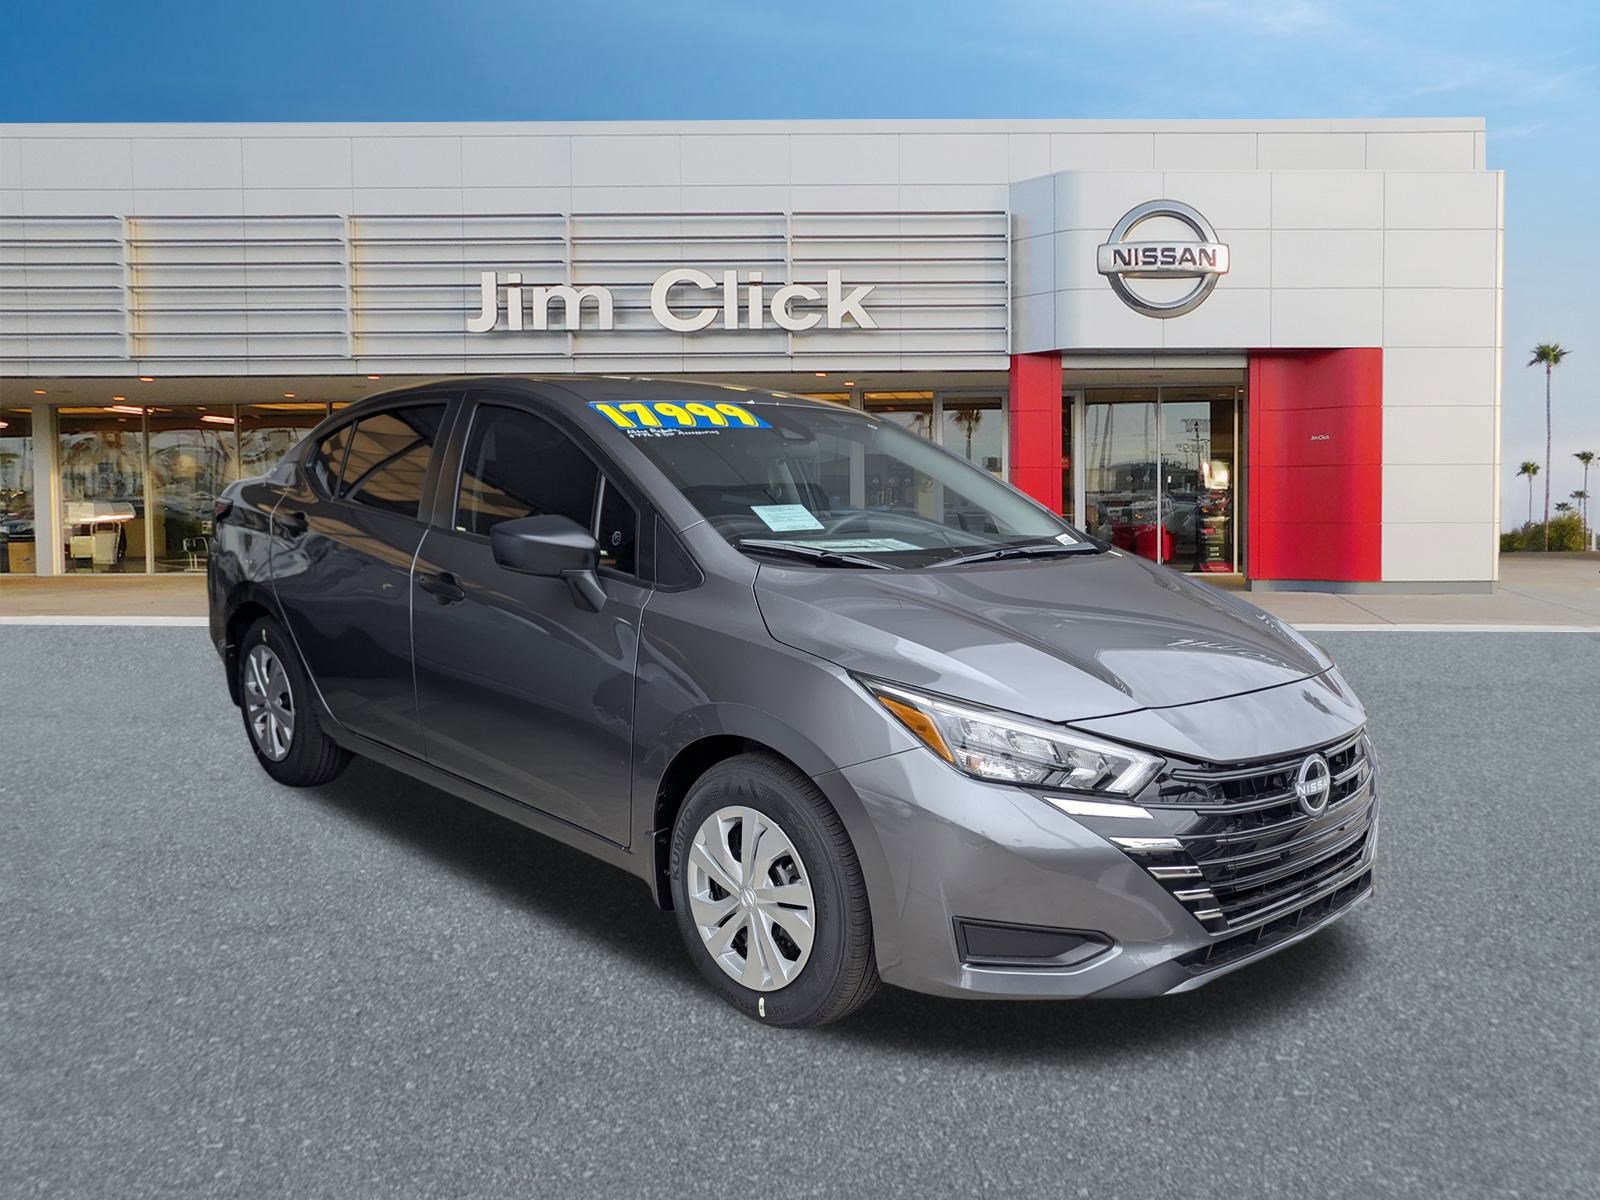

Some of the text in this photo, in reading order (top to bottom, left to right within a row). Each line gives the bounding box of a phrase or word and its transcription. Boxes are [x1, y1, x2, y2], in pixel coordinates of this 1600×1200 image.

[1112, 247, 1217, 267] NISSAN
[467, 268, 879, 333] Jim Click
[594, 402, 760, 429] 17999
